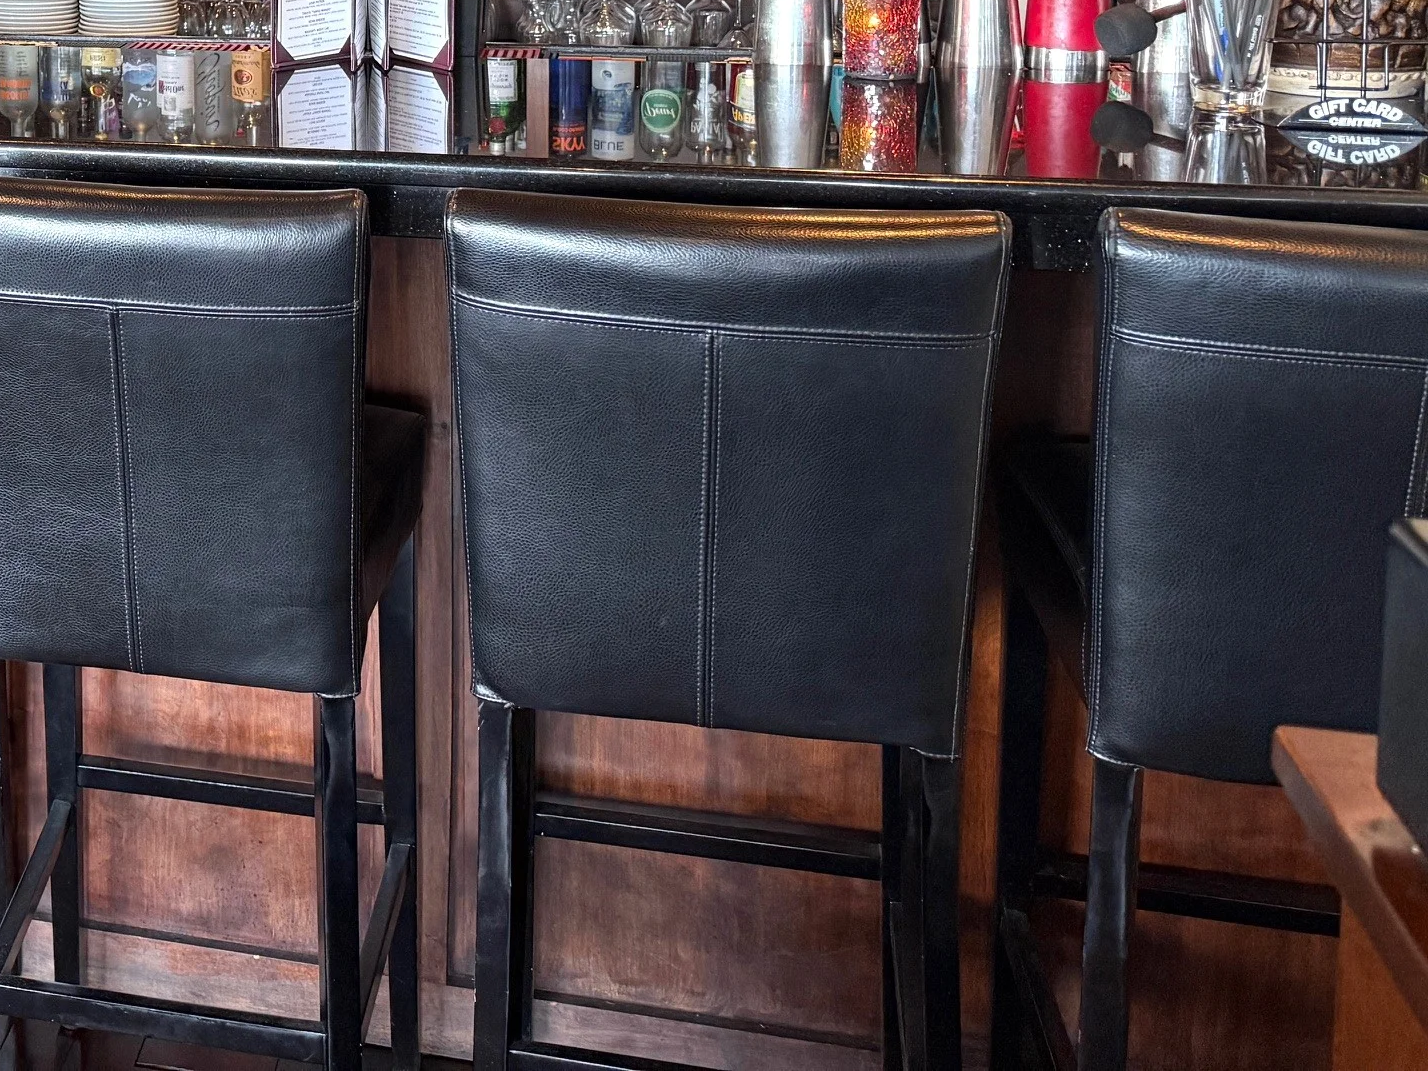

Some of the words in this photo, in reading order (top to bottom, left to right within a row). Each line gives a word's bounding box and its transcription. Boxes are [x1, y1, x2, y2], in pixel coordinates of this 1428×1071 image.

[1308, 98, 1350, 120] GIFT
[1352, 98, 1404, 122] CARD
[1328, 117, 1382, 128] CENTER
